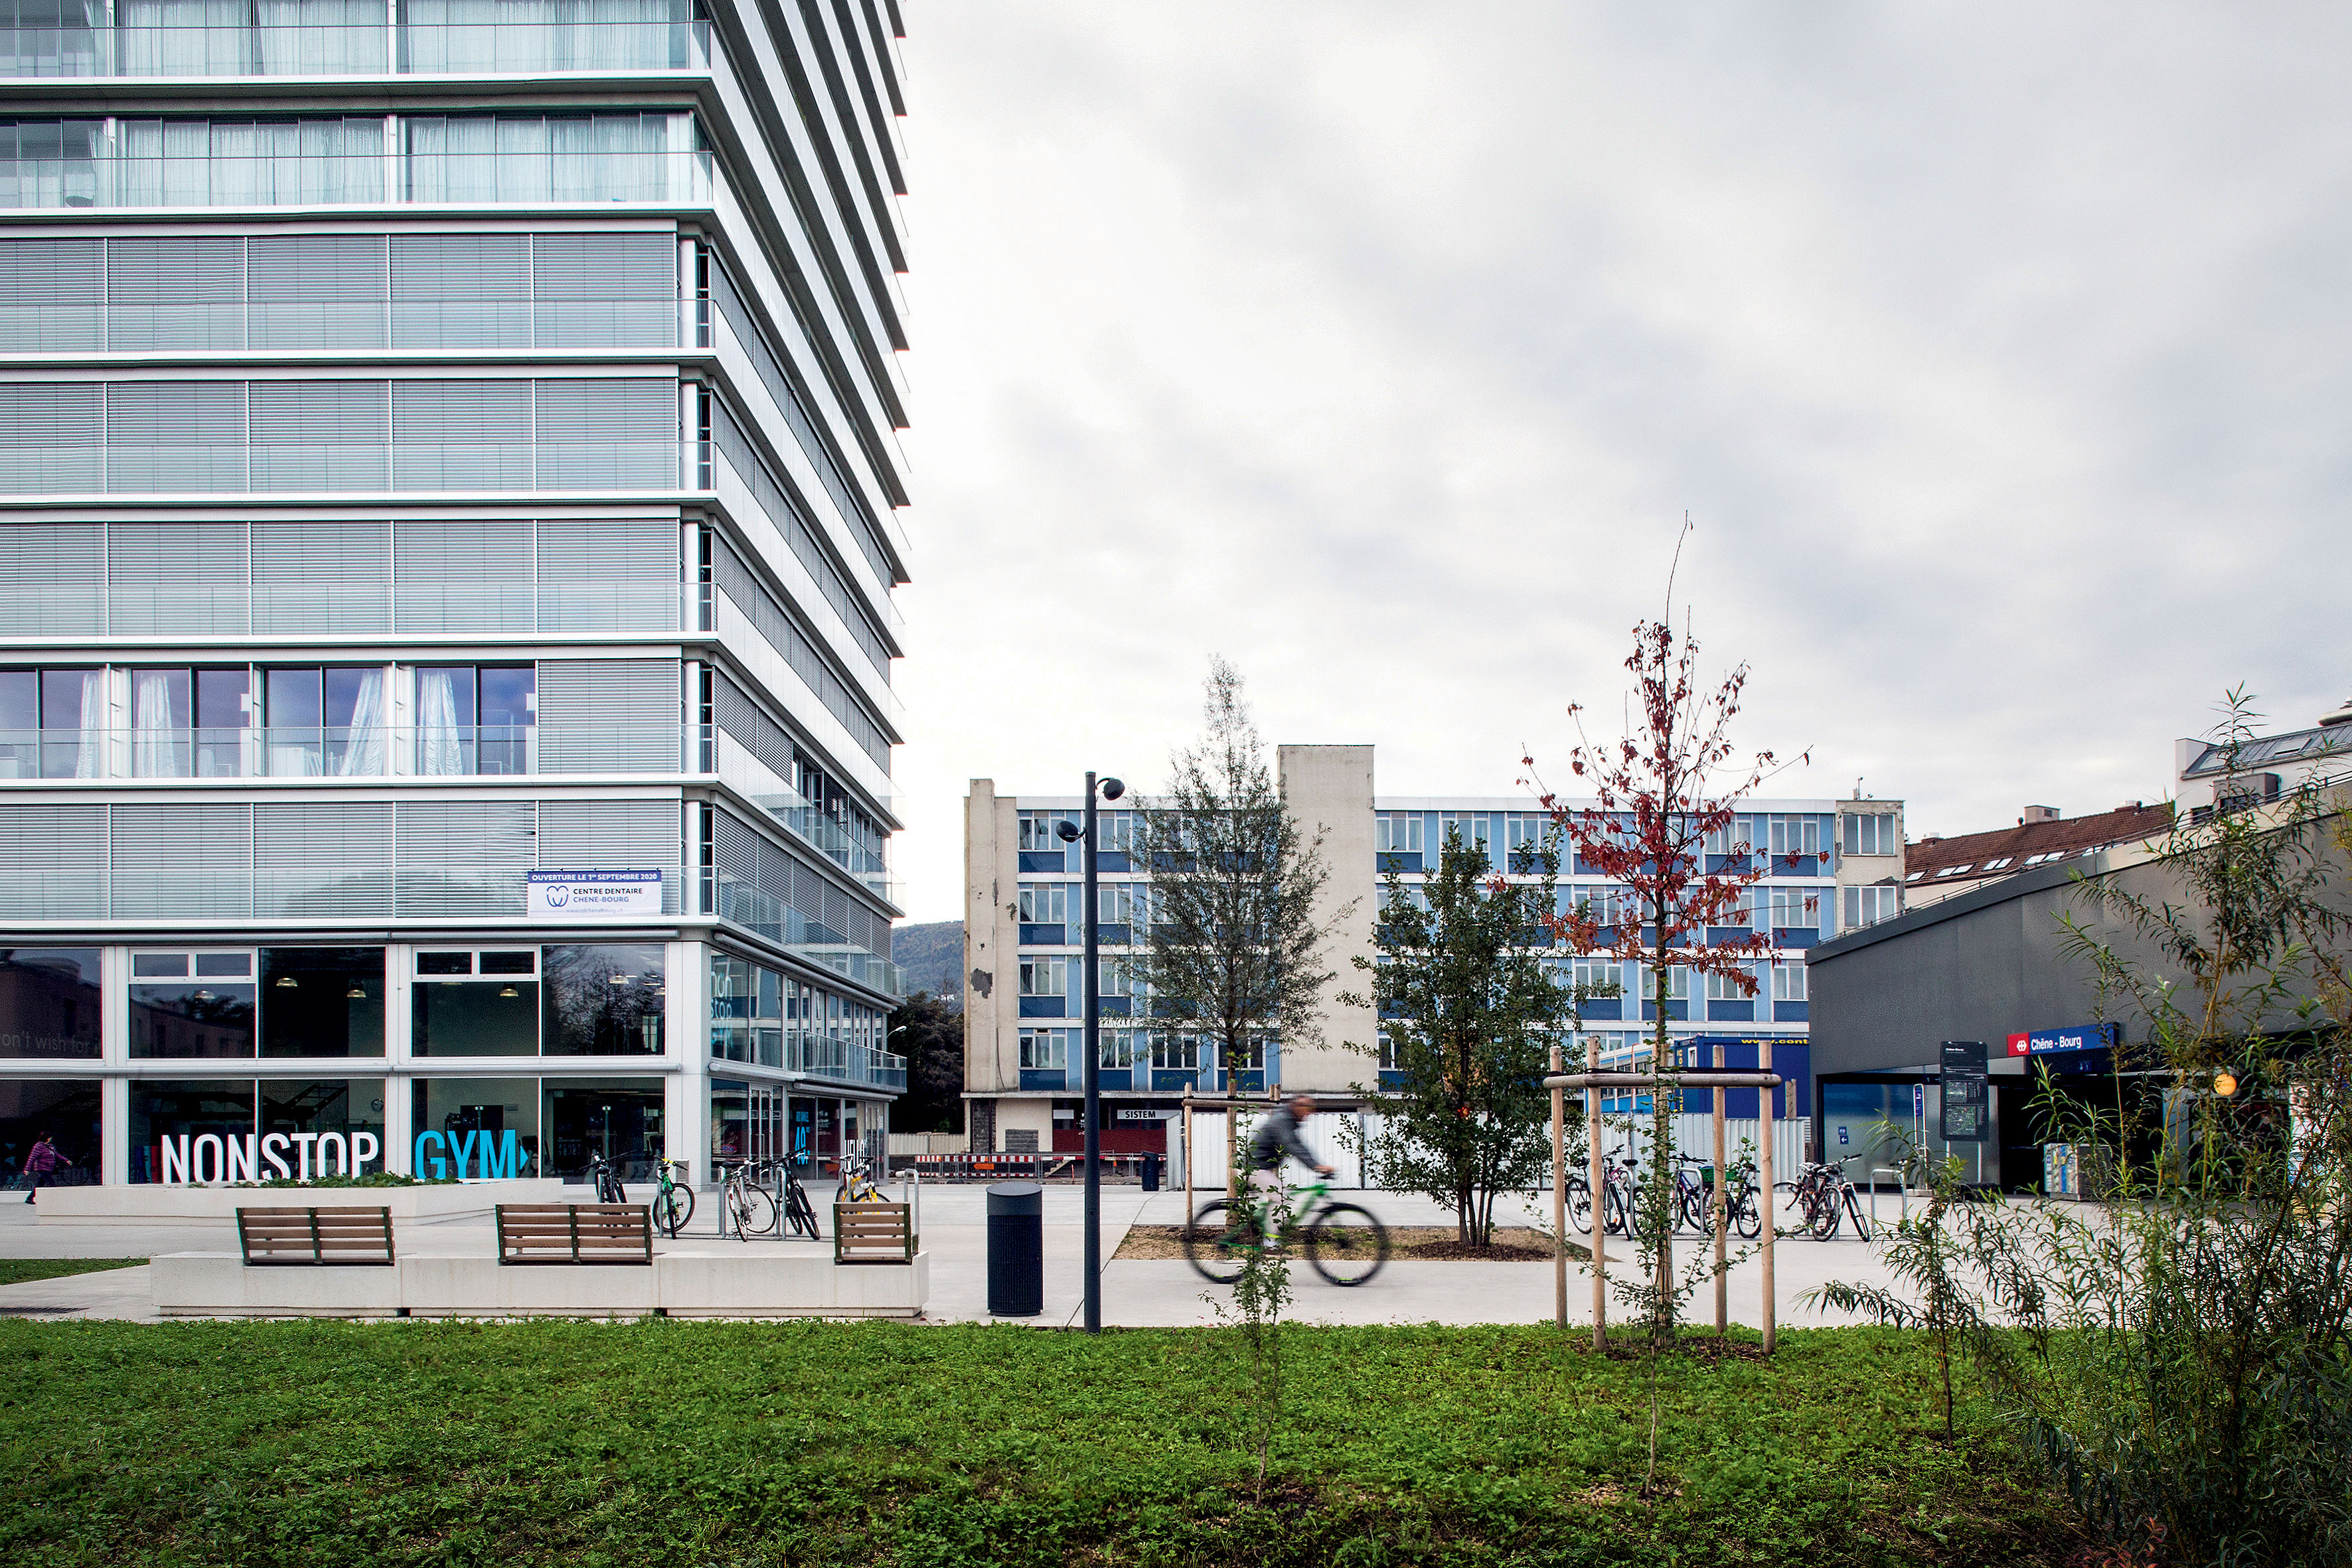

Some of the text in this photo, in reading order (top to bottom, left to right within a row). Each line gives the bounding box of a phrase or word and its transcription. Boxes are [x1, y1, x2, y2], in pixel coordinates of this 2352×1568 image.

[0, 1030, 31, 1048] on't
[36, 1032, 66, 1052] wish
[2031, 1038, 2053, 1051] Chêne
[2059, 1036, 2082, 1048] Bourg
[161, 1129, 516, 1183] NONSTOP GYM
